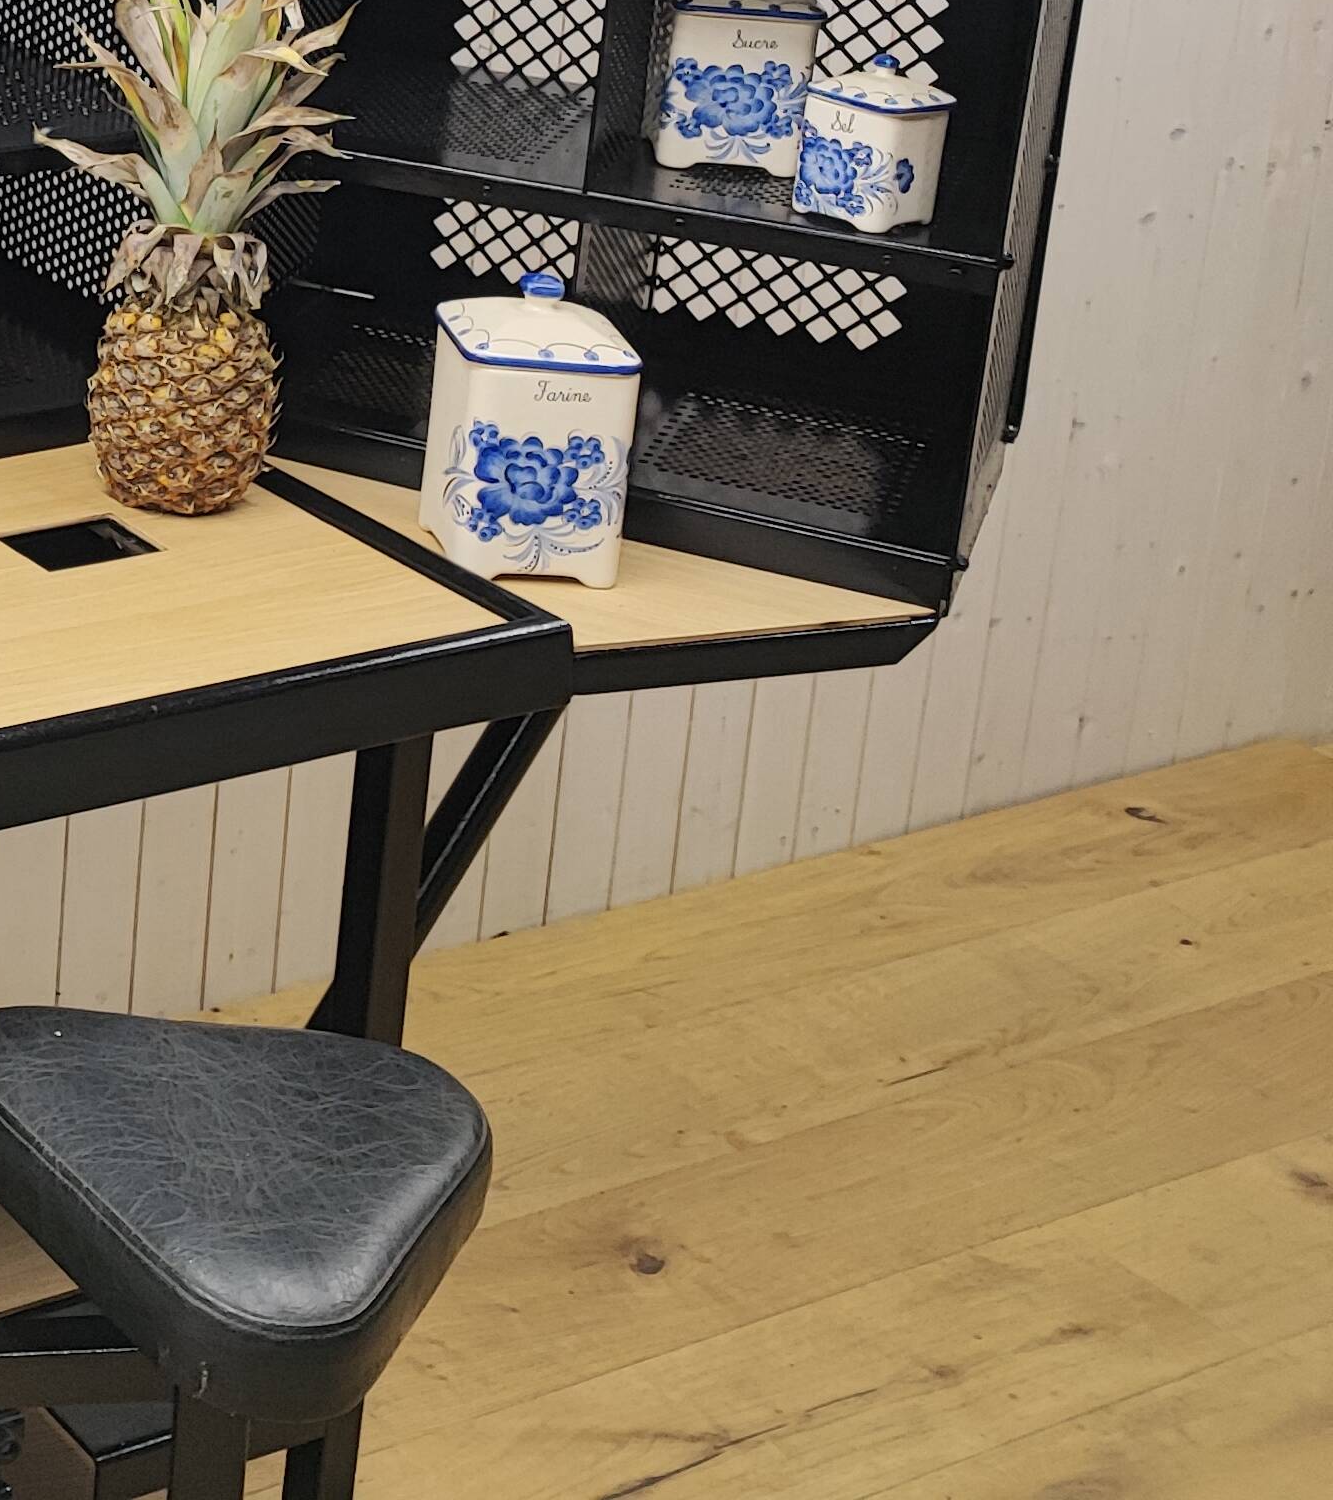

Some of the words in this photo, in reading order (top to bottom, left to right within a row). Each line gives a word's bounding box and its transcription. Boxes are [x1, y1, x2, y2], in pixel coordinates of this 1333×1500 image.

[732, 29, 779, 49] Sucre
[830, 110, 855, 133] Sel
[533, 379, 592, 403] Farine
